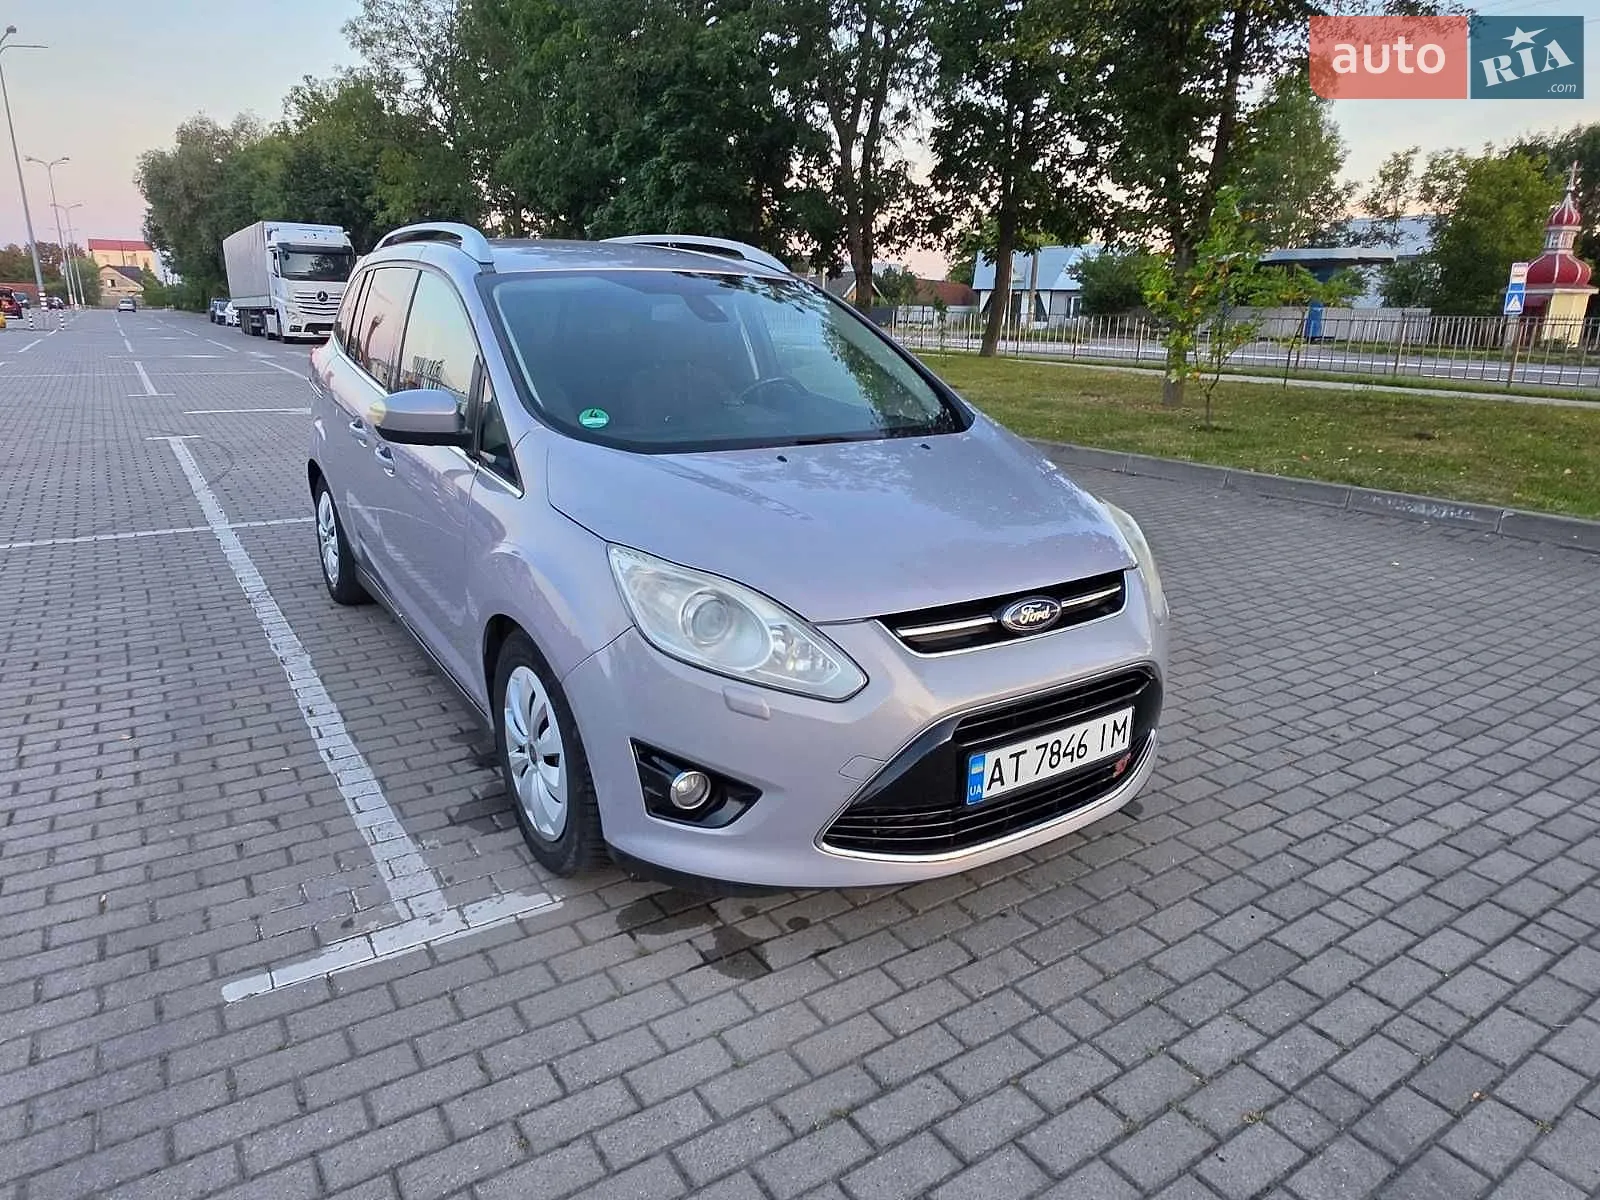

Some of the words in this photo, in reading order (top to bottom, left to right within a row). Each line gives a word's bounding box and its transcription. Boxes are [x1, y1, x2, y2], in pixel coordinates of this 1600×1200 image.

[1019, 602, 1051, 625] Ford
[986, 749, 1028, 792] AT
[1034, 728, 1089, 776] 7846
[1099, 714, 1128, 753] IM
[969, 783, 982, 797] UA
